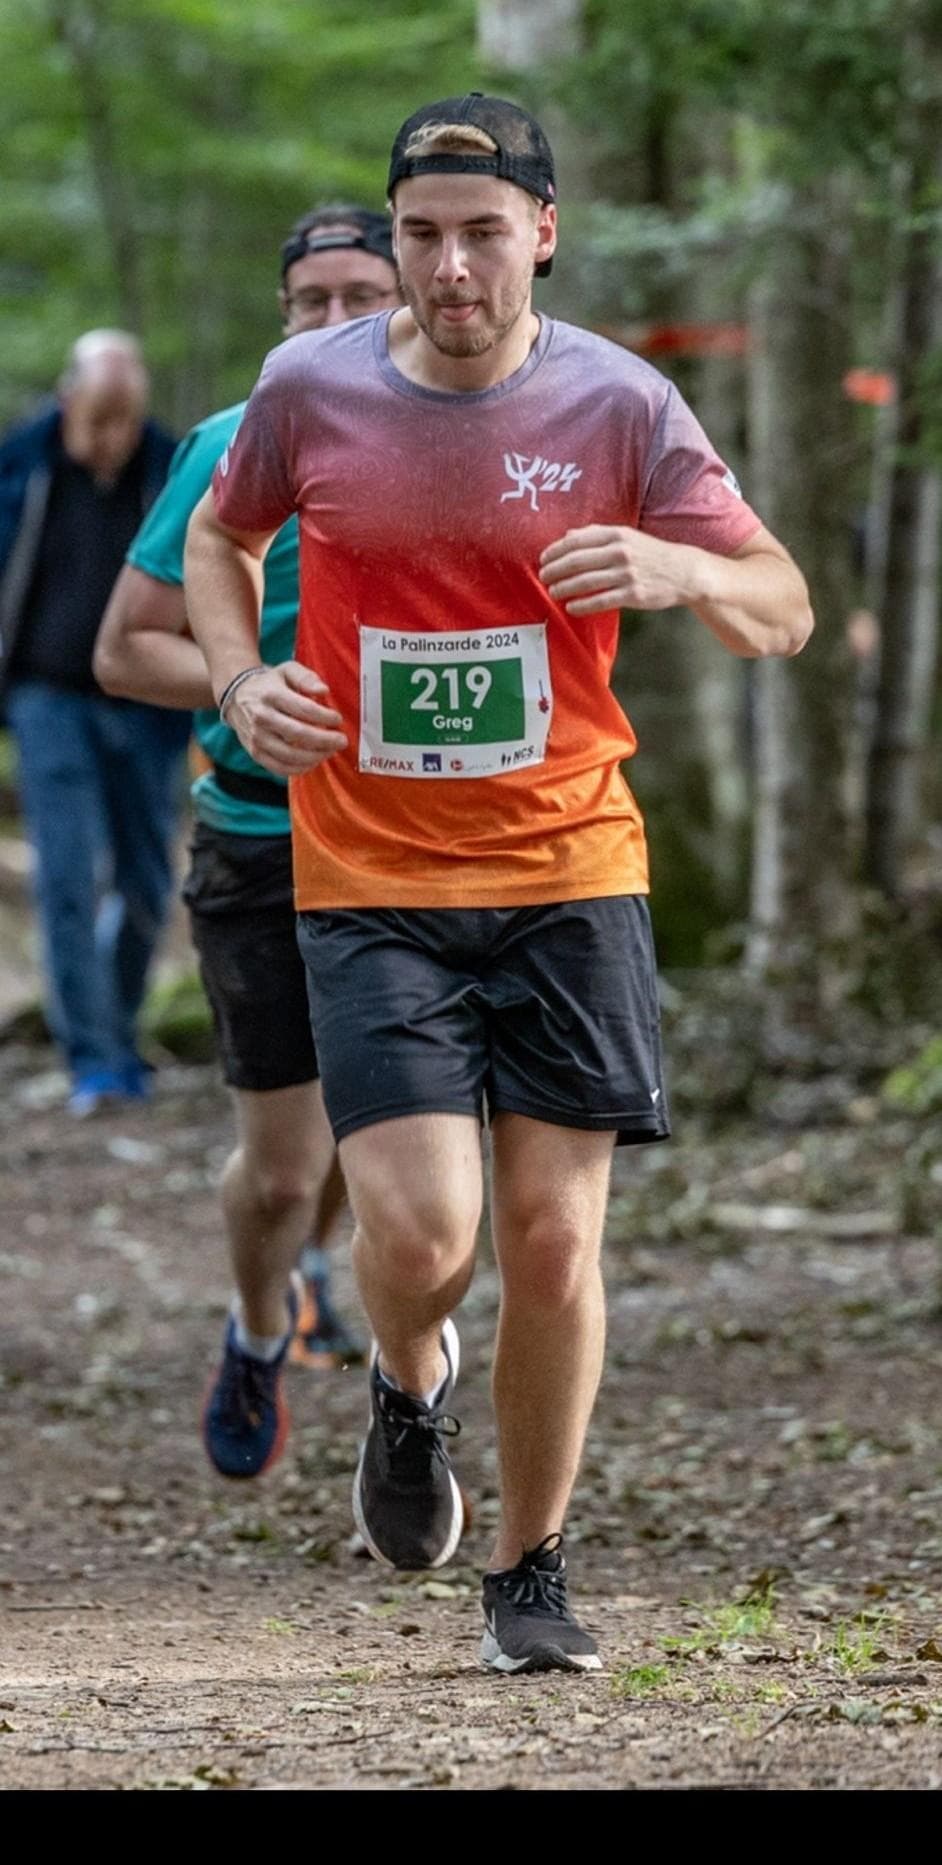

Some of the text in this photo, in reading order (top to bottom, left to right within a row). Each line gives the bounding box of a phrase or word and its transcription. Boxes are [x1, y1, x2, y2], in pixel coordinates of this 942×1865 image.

[382, 632, 519, 652] La Palinzarde 2024
[410, 665, 492, 710] 219
[432, 714, 473, 732] Greg
[513, 745, 535, 761] NCS
[369, 756, 414, 771] RE/MAX
